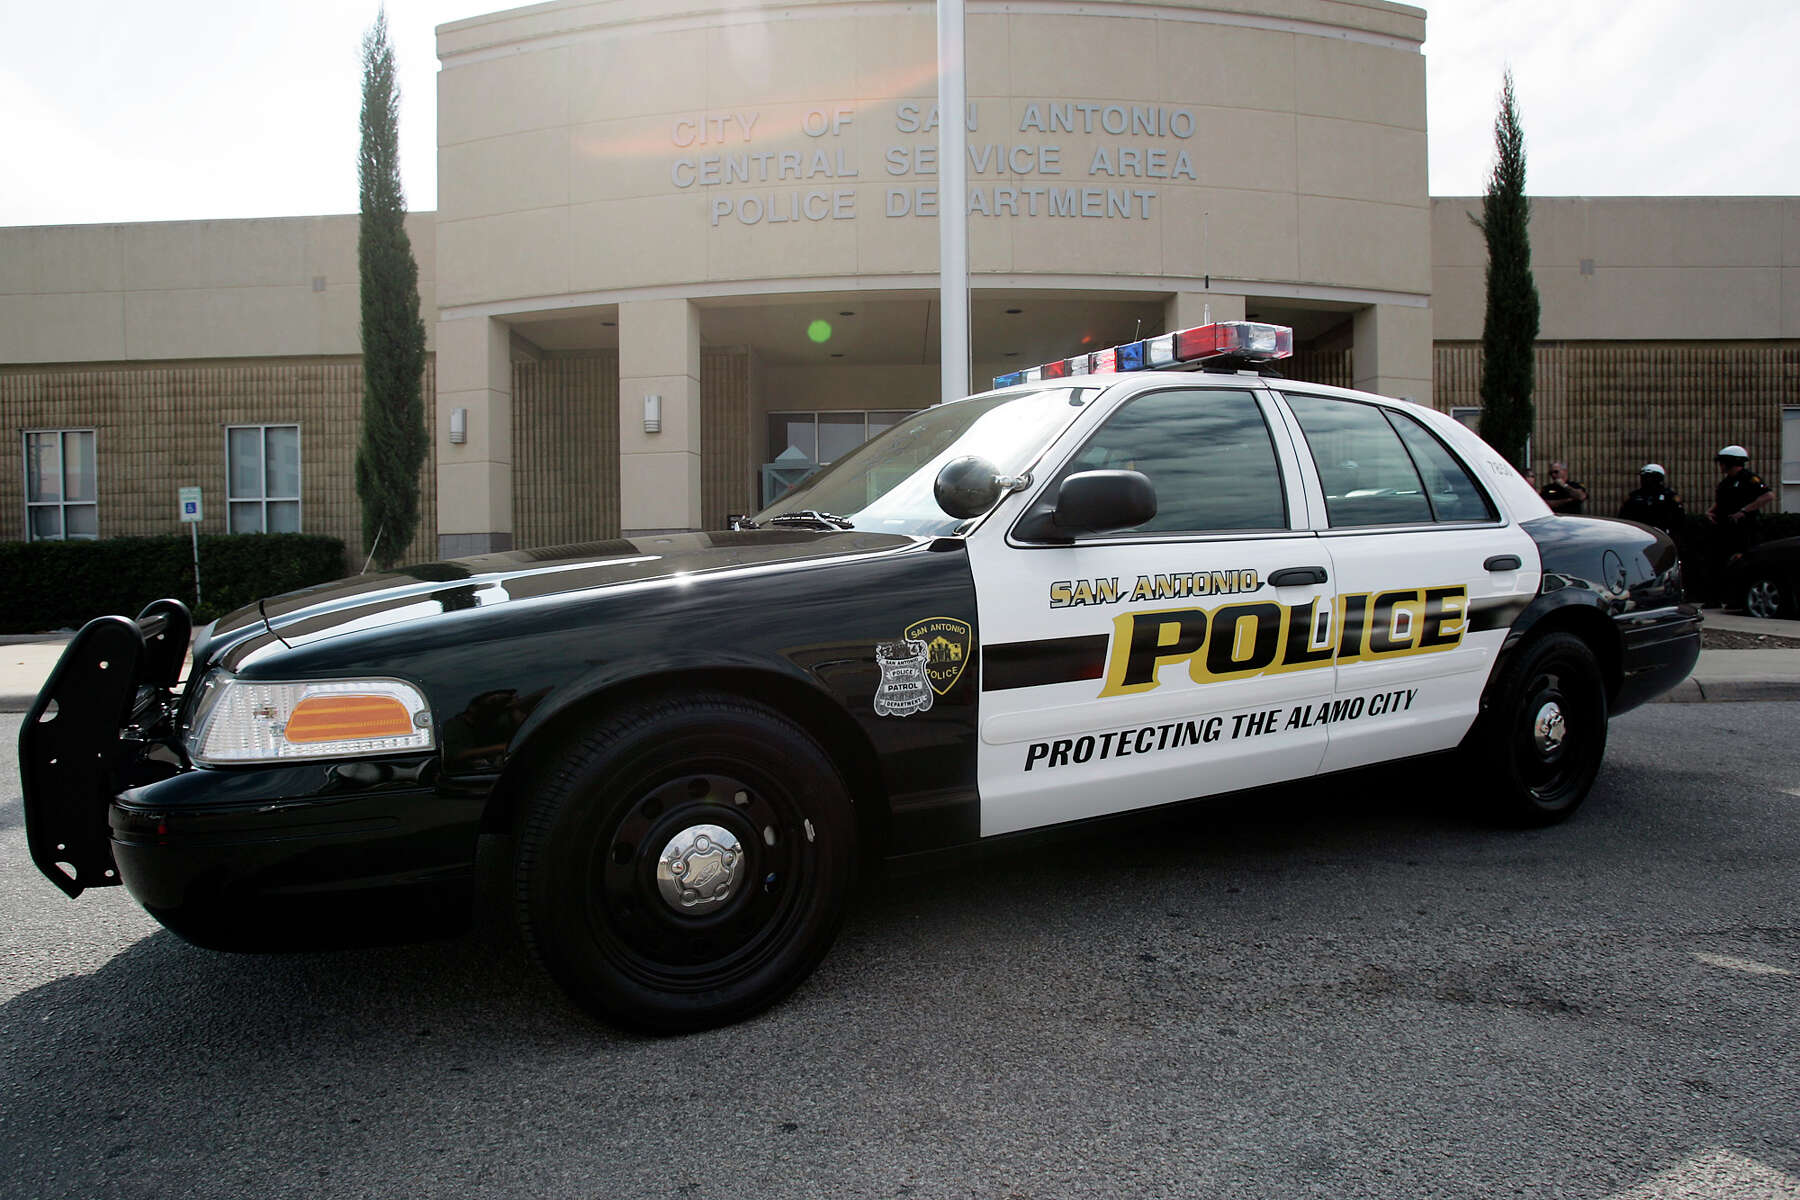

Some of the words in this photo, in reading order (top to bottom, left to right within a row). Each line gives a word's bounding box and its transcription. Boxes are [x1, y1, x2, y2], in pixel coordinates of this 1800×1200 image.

[672, 112, 760, 148] CITY
[803, 107, 856, 137] OF
[1019, 103, 1196, 138] ANTONIO
[672, 148, 859, 188] CENTRAL
[886, 144, 1061, 176] SEVICE
[1089, 148, 1197, 180] AREA
[712, 190, 856, 227] POLICE
[886, 187, 1157, 219] DEARTMENT
[1050, 577, 1123, 609] SAN
[1129, 569, 1262, 602] ANTONIO
[911, 626, 928, 639] SAN
[930, 623, 966, 635] ANTONIO
[1097, 584, 1469, 699] POLICE
[888, 682, 919, 692] PATROL
[892, 669, 913, 677] POLICE
[925, 666, 959, 680] POLICE
[886, 698, 922, 708] DEPARTMENT
[1024, 716, 1223, 772] PROTECTING
[1231, 709, 1282, 740] THE
[1285, 696, 1364, 731] ALAMO
[1368, 688, 1419, 716] CITY
